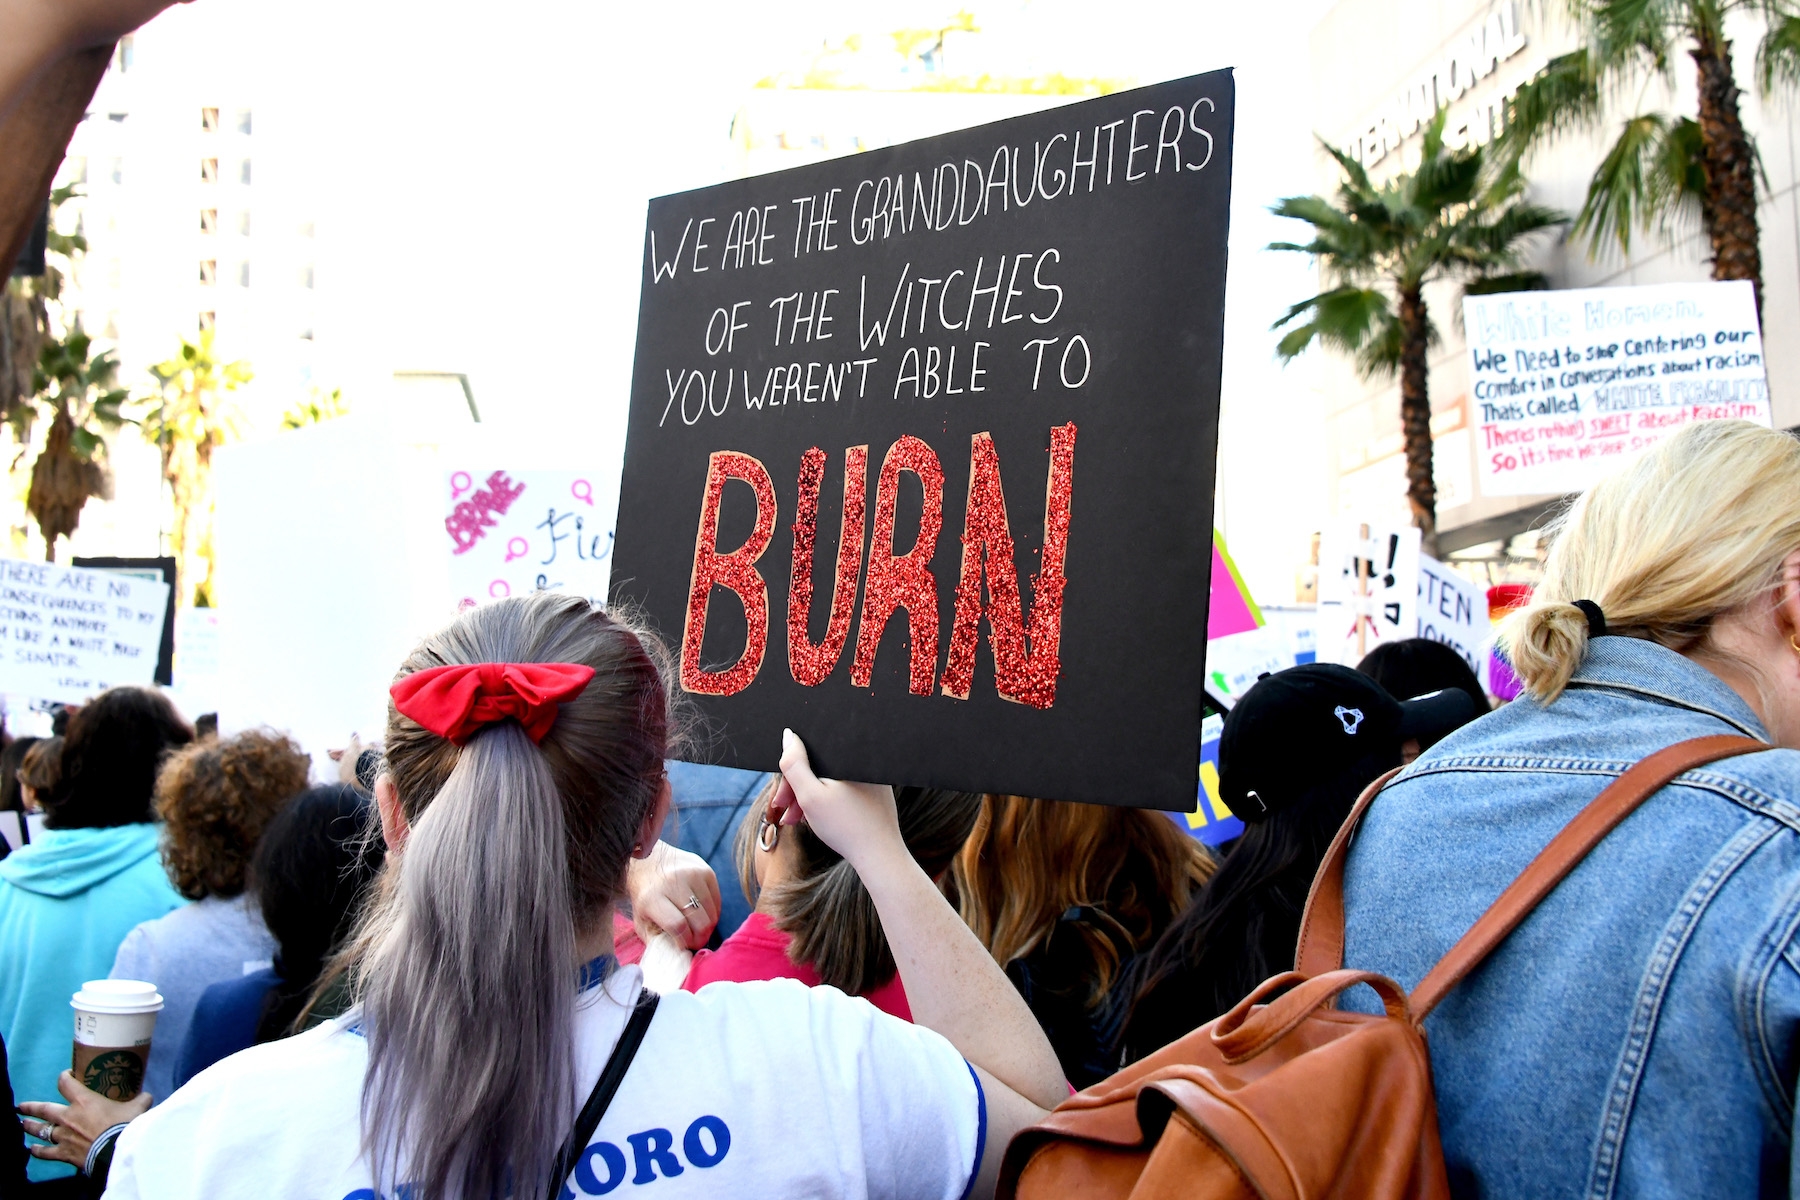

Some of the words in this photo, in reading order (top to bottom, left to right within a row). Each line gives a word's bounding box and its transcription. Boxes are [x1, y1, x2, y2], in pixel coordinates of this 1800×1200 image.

[650, 217, 716, 284] WE
[721, 205, 778, 271] ARE
[791, 188, 842, 259] THE
[850, 96, 1216, 246] GRANDDAUGHTERS
[704, 300, 752, 357] OF
[768, 288, 840, 347] THE
[858, 247, 1064, 352] WITCHES
[1475, 299, 1571, 345] White
[1474, 346, 1508, 374] We
[1563, 344, 1581, 365] to
[1540, 373, 1556, 392] in
[1661, 358, 1701, 375] about
[1705, 350, 1761, 371] racism
[658, 367, 734, 428] YOU
[742, 356, 878, 411] WEREN'T
[893, 340, 990, 400] ABLE
[1021, 333, 1092, 391] TO
[1594, 381, 1664, 414] WHITE
[1538, 419, 1585, 441] nothing
[1590, 413, 1633, 437] SWEET
[1637, 404, 1688, 429] about
[1491, 452, 1518, 474] So
[0, 560, 50, 589] THERE
[55, 570, 97, 595] ARE
[106, 579, 132, 599] NO
[679, 420, 1079, 710] BURN
[115, 605, 134, 621] TO
[49, 632, 60, 648] A
[562, 1114, 732, 1200] ORO
